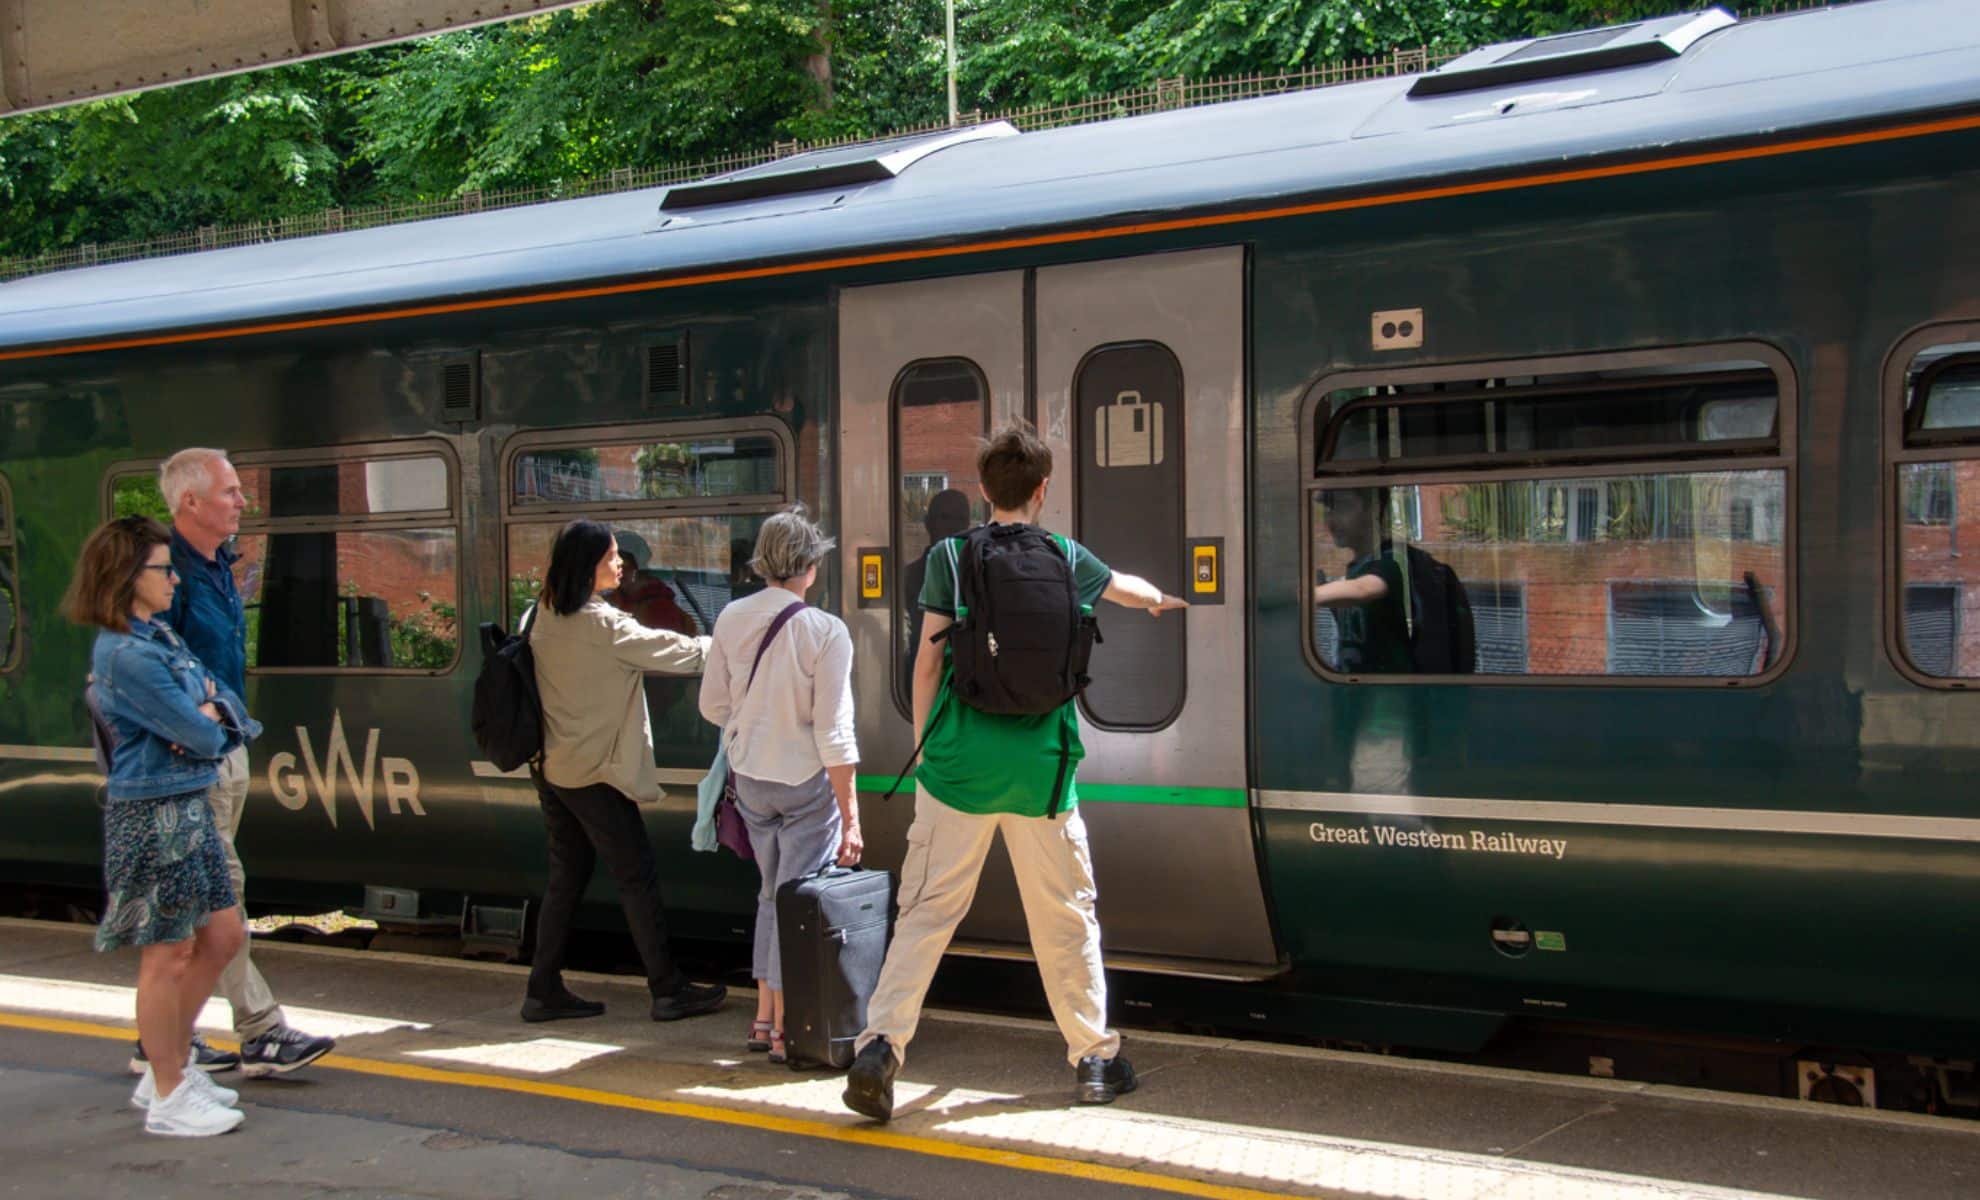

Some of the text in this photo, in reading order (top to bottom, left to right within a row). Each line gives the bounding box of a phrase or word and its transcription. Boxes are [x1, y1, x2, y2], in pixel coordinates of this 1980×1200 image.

[268, 707, 427, 831] GWR
[1309, 822, 1567, 859] Great Western Railway
[263, 1043, 281, 1058] N
